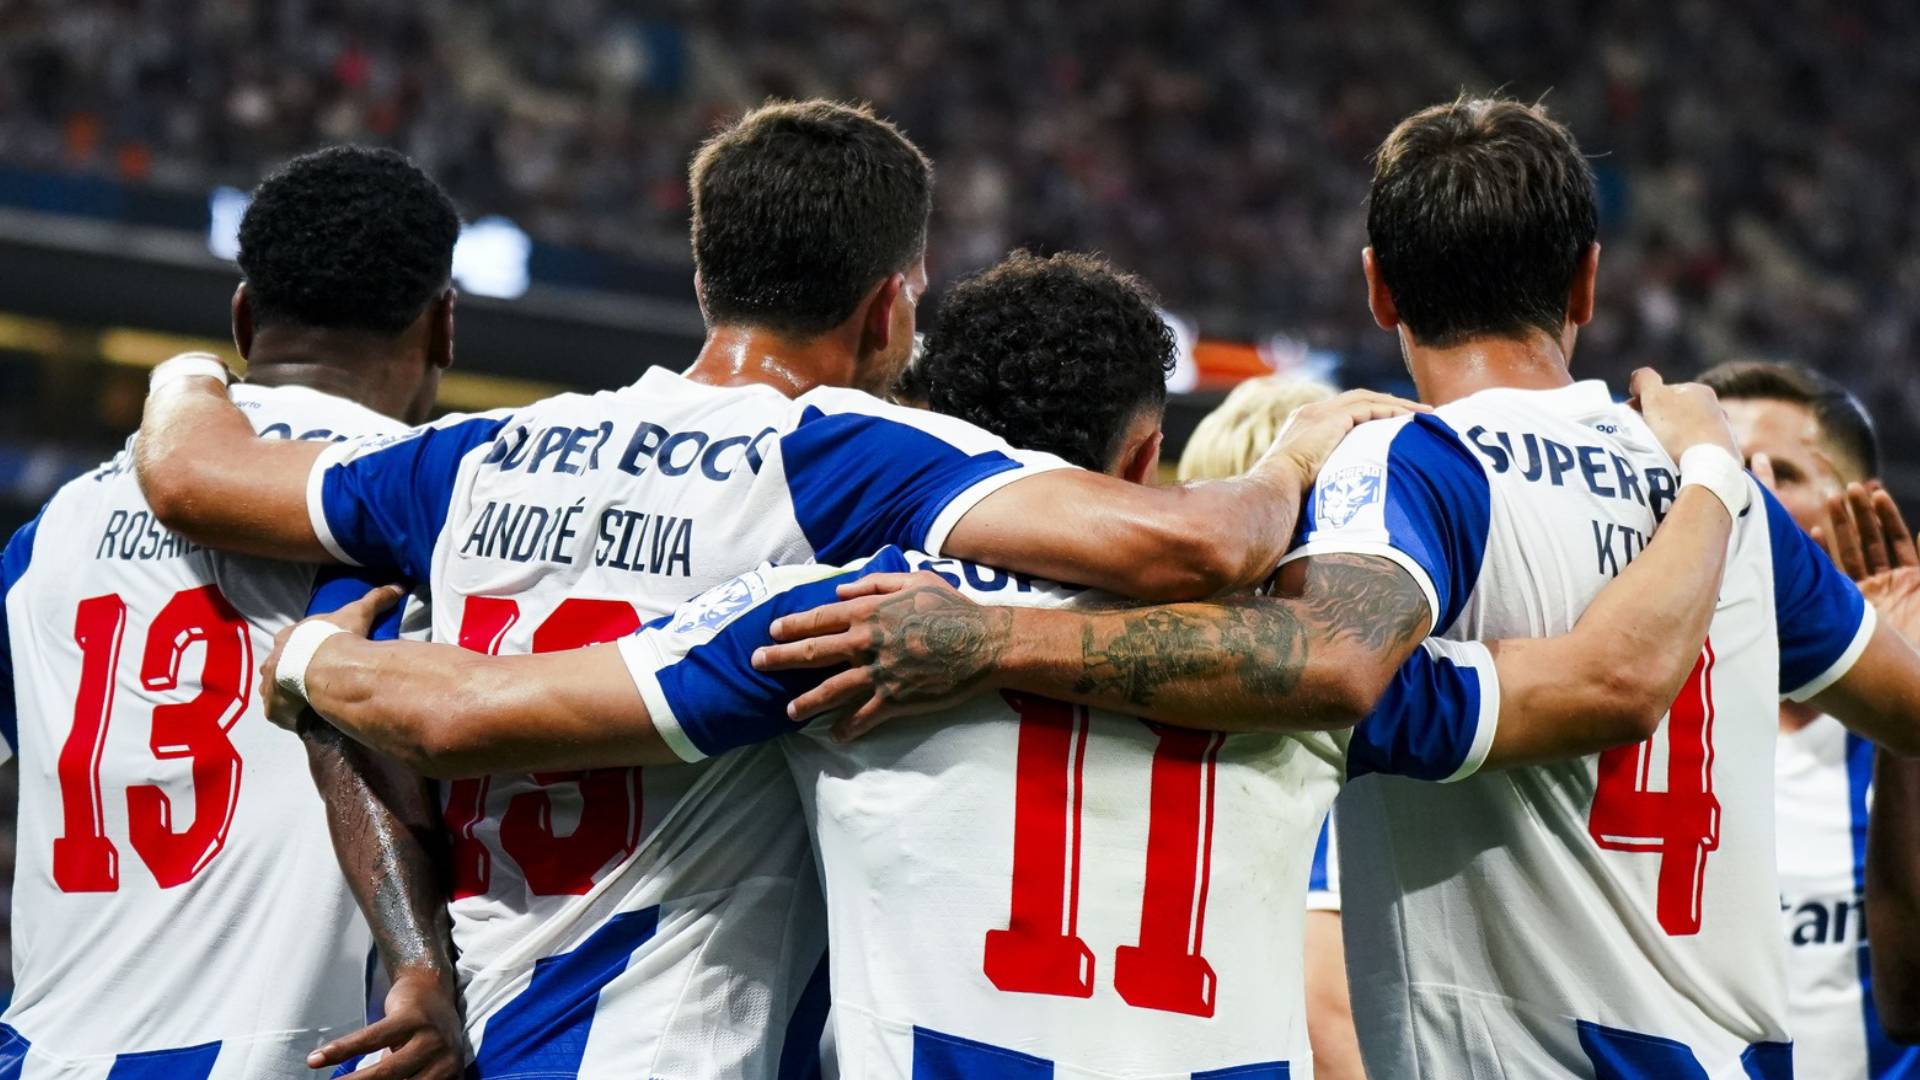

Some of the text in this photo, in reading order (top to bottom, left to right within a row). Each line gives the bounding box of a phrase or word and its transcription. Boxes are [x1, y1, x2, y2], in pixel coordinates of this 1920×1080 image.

[96, 510, 201, 560] ROSA
[461, 497, 693, 577] ANDRÉ SILVA
[1467, 425, 1647, 508] SUPER
[53, 585, 251, 893] 13
[1588, 635, 1721, 937] 4
[983, 687, 1226, 1019] 11
